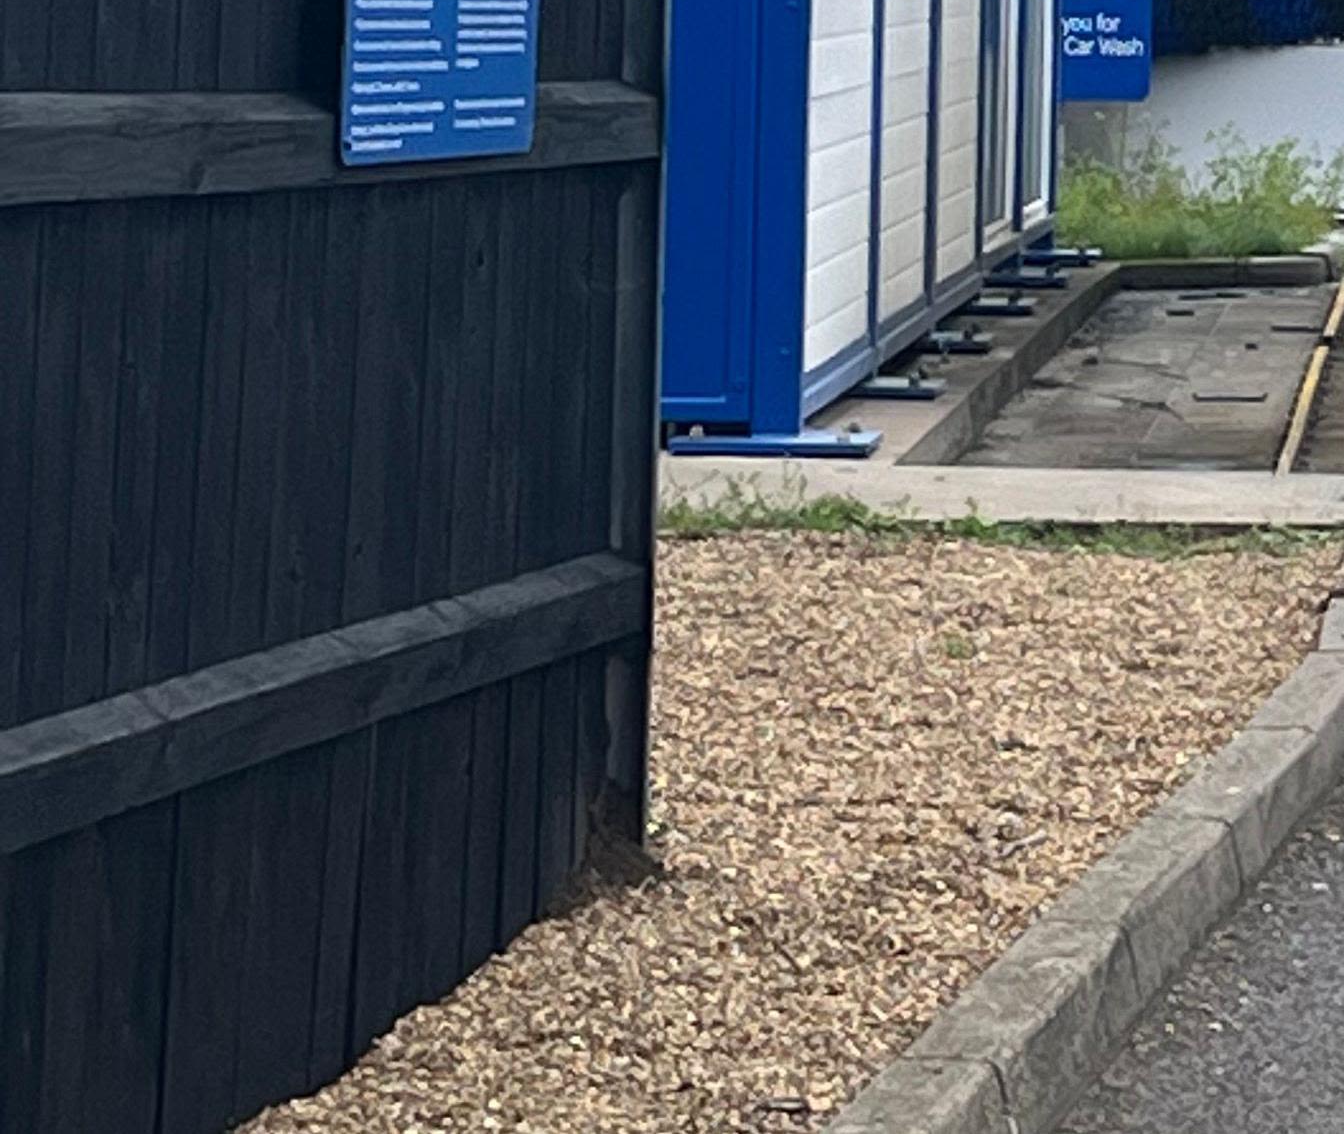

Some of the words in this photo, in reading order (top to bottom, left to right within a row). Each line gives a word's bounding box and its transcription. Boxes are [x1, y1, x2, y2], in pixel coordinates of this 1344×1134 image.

[1060, 16, 1093, 36] you
[1096, 11, 1121, 33] for
[1063, 35, 1096, 57] Car
[1097, 35, 1145, 57] Wash
